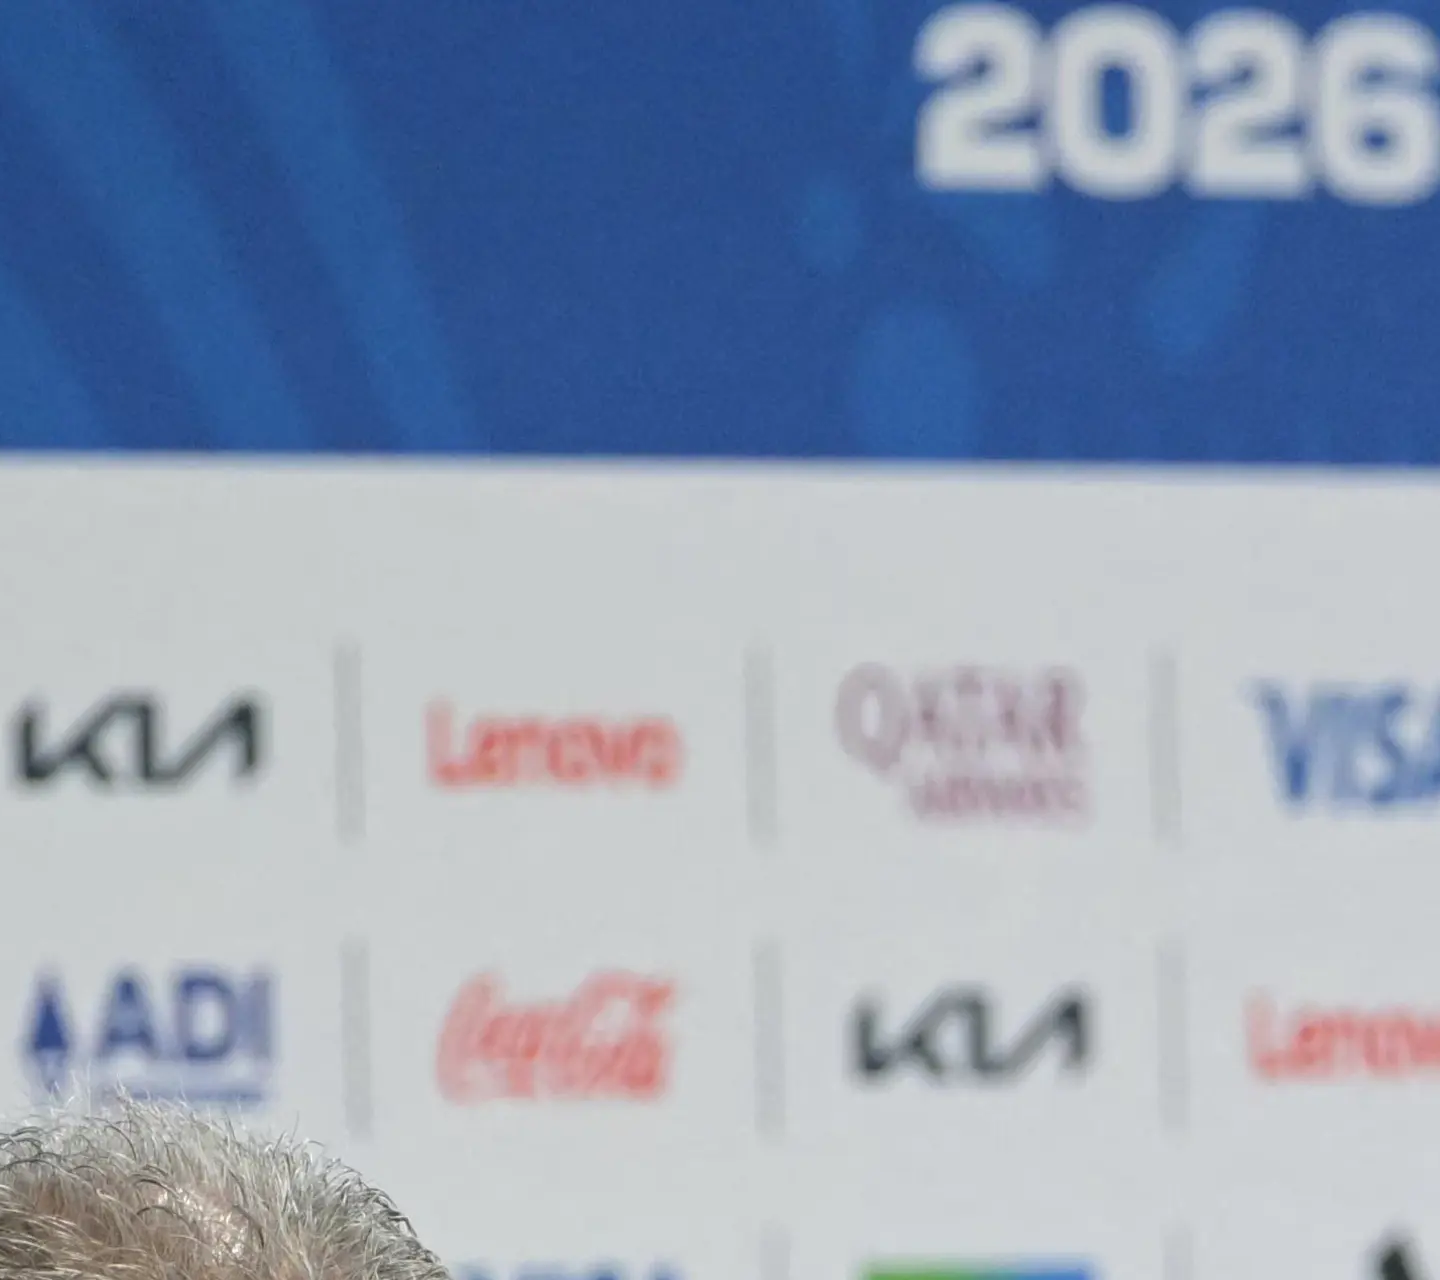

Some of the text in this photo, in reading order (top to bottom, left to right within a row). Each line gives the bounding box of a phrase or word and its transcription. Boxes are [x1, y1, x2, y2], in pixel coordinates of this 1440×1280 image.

[13, 695, 263, 789] KIA
[429, 711, 679, 788] Lenovo
[94, 970, 272, 1064] ADI
[851, 989, 1092, 1084] KIA
